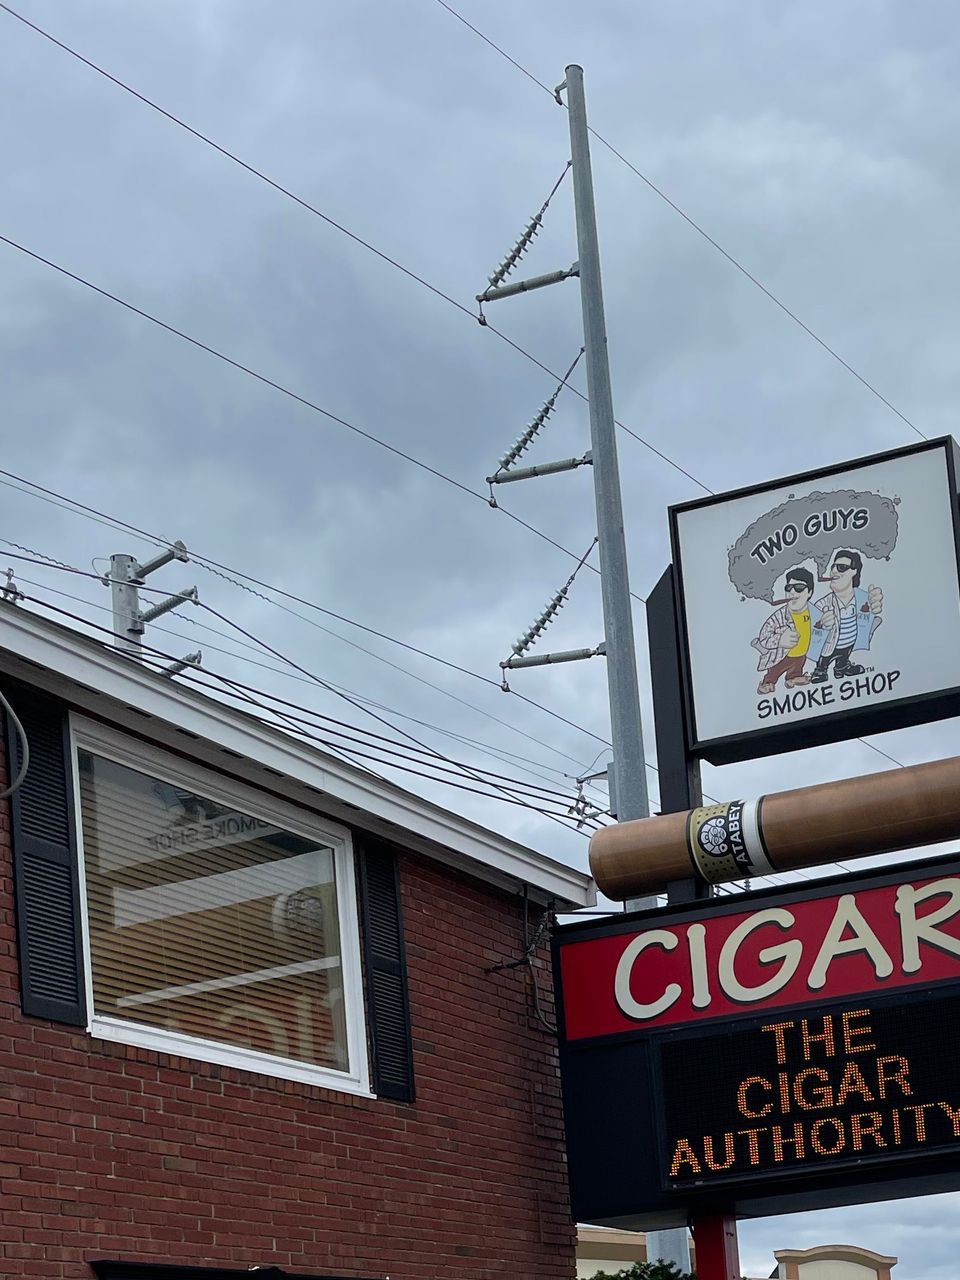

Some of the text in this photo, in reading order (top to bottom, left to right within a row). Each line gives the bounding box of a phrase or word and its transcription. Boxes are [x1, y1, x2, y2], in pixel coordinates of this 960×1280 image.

[751, 508, 869, 564] TWO GUYS
[757, 670, 901, 719] SMOKE SHOP
[728, 804, 749, 863] ATABEY
[761, 1009, 877, 1065] THE
[736, 1055, 913, 1119] CIGAR
